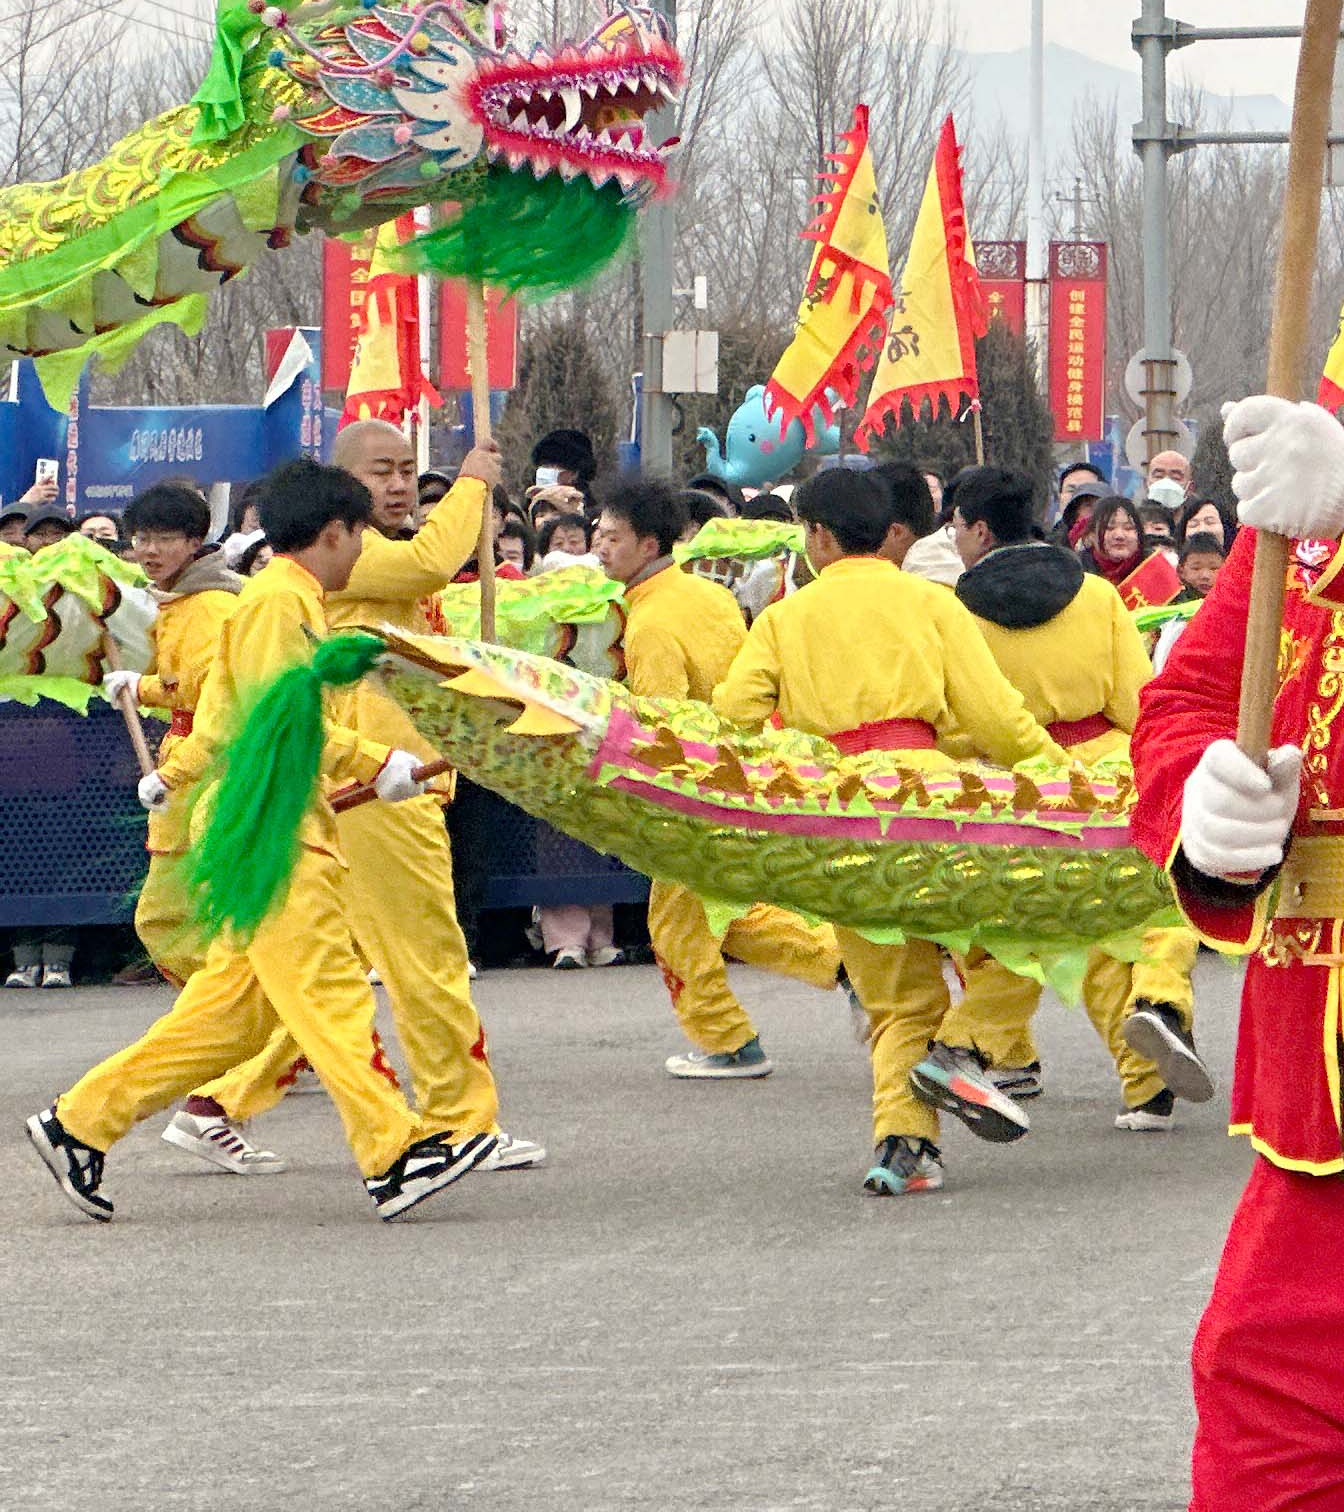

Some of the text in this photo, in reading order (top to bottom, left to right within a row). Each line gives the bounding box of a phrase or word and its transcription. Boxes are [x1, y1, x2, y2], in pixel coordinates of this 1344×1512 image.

[1065, 289, 1085, 433] 创建全民运动健身模范县
